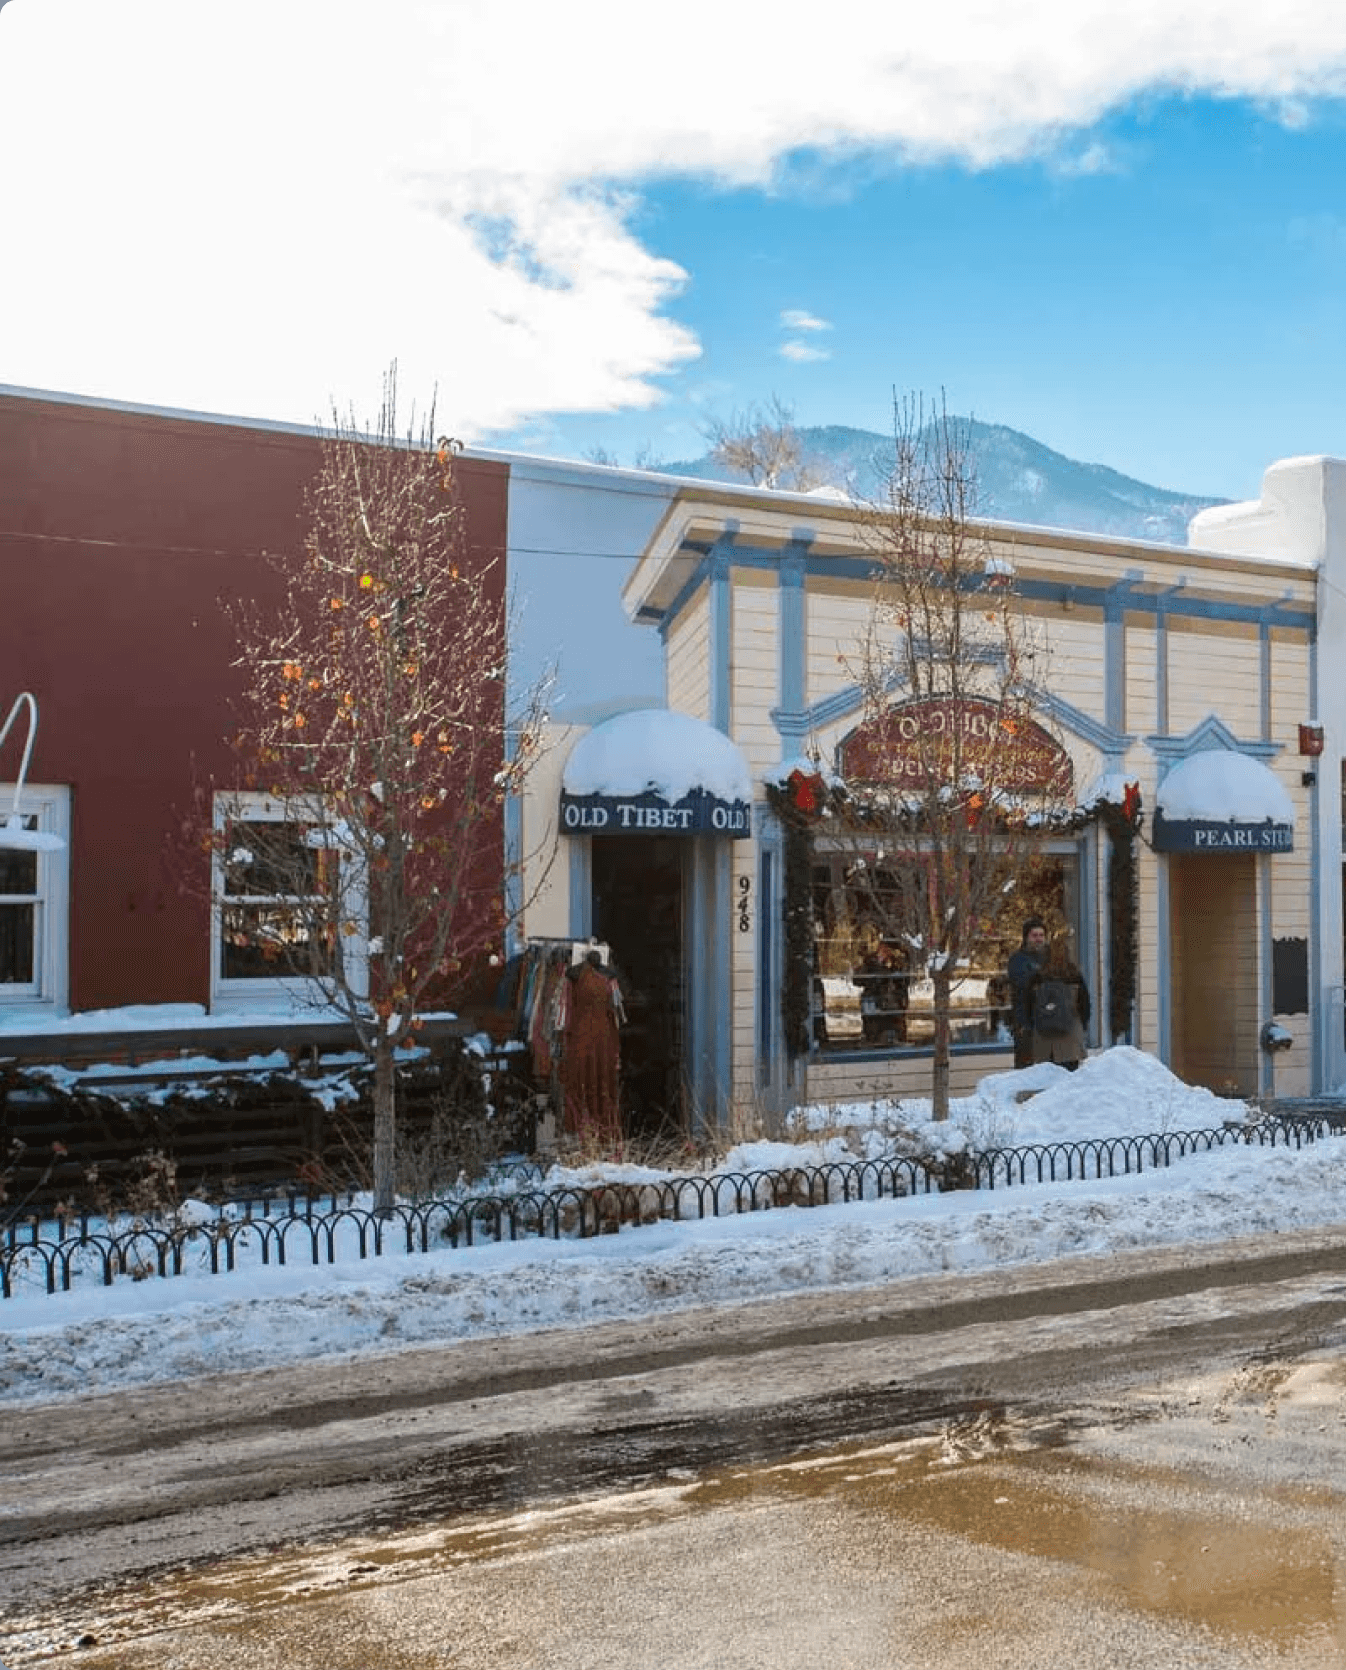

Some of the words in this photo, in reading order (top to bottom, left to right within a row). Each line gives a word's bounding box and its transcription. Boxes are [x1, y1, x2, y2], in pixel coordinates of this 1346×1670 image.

[564, 804, 609, 828] OLD
[616, 804, 694, 829] TIBET
[711, 806, 745, 830] OLD
[1194, 829, 1259, 846] PEARL
[738, 876, 750, 933] 948
